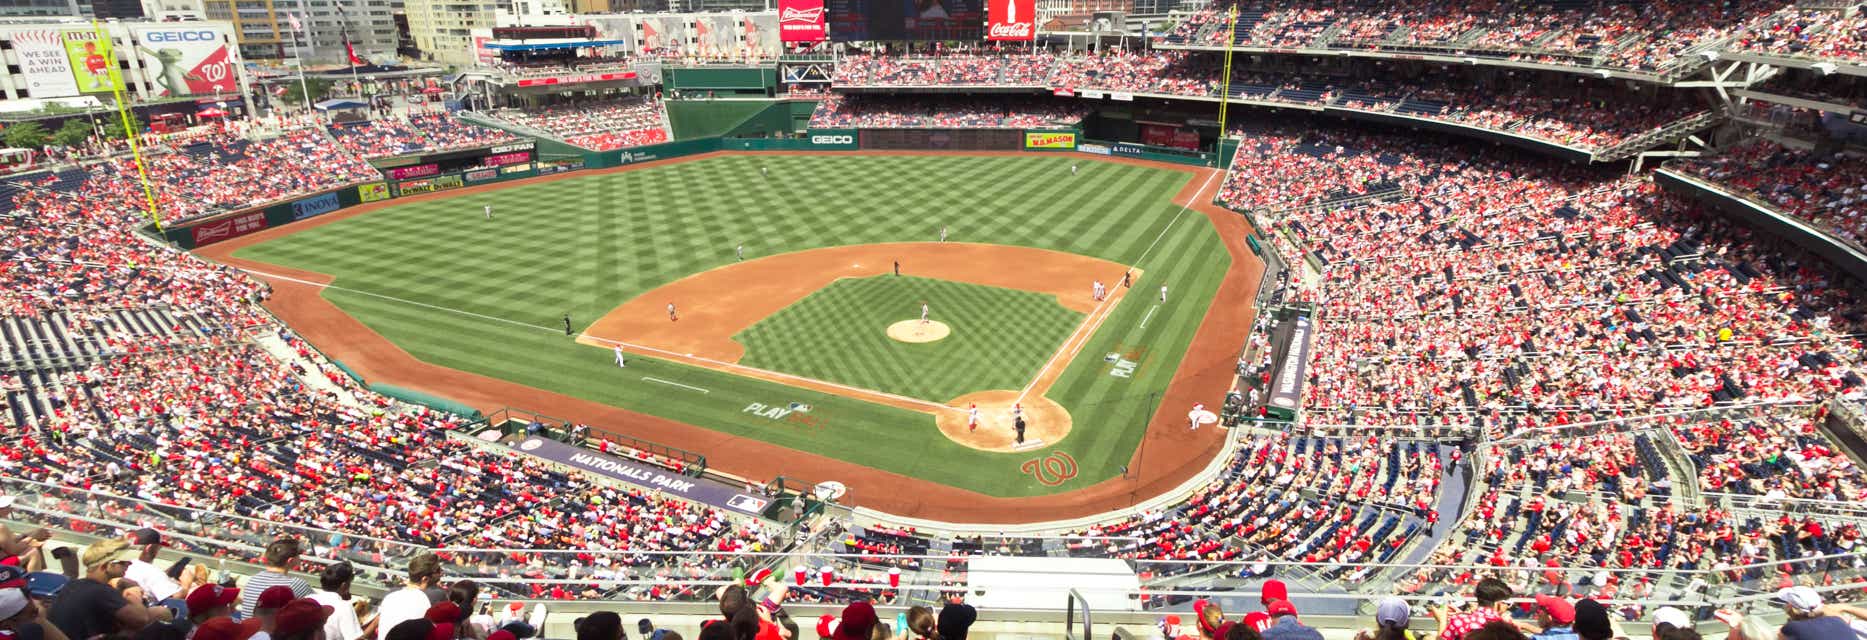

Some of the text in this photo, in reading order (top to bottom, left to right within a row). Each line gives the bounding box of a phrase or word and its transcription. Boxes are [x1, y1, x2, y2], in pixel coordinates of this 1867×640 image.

[990, 22, 1032, 37] Coca-Cola
[146, 30, 216, 42] GEICO
[23, 50, 41, 58] WE
[28, 58, 36, 66] A
[29, 66, 66, 74] AHEAD
[811, 135, 853, 144] GEICO
[1119, 146, 1141, 154] DELTA
[303, 194, 338, 214] INOVA
[742, 402, 792, 420] PLAY
[570, 452, 696, 493] NATIONALS PARK
